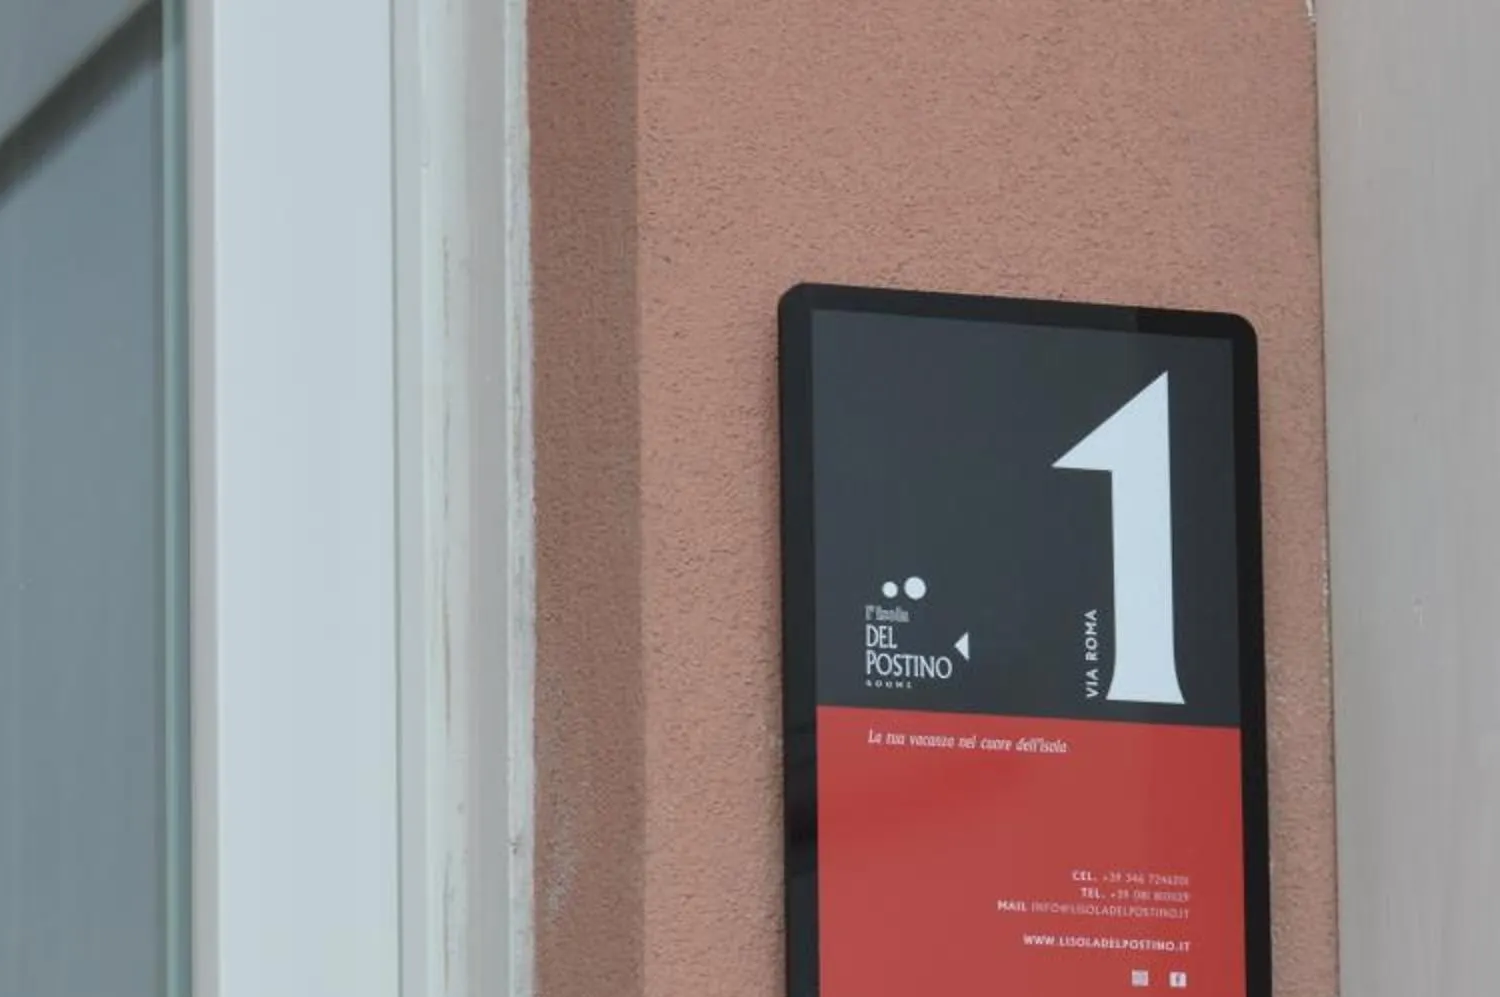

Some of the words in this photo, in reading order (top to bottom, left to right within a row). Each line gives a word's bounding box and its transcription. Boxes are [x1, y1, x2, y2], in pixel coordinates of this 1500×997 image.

[1051, 370, 1185, 704] 1
[865, 624, 898, 650] DEL
[1084, 608, 1098, 661] ROMA
[865, 649, 953, 680] POSTINO
[1086, 669, 1099, 699] VIA
[868, 728, 882, 744] La
[886, 732, 905, 745] tua
[909, 734, 954, 749] vacanza
[958, 735, 975, 749] nel
[980, 737, 1012, 751] cuore
[997, 900, 1027, 912] MAIL
[1080, 887, 1105, 899] TEL.
[1022, 933, 1191, 952] WWW.LISOLADELPOSTINO.IT
